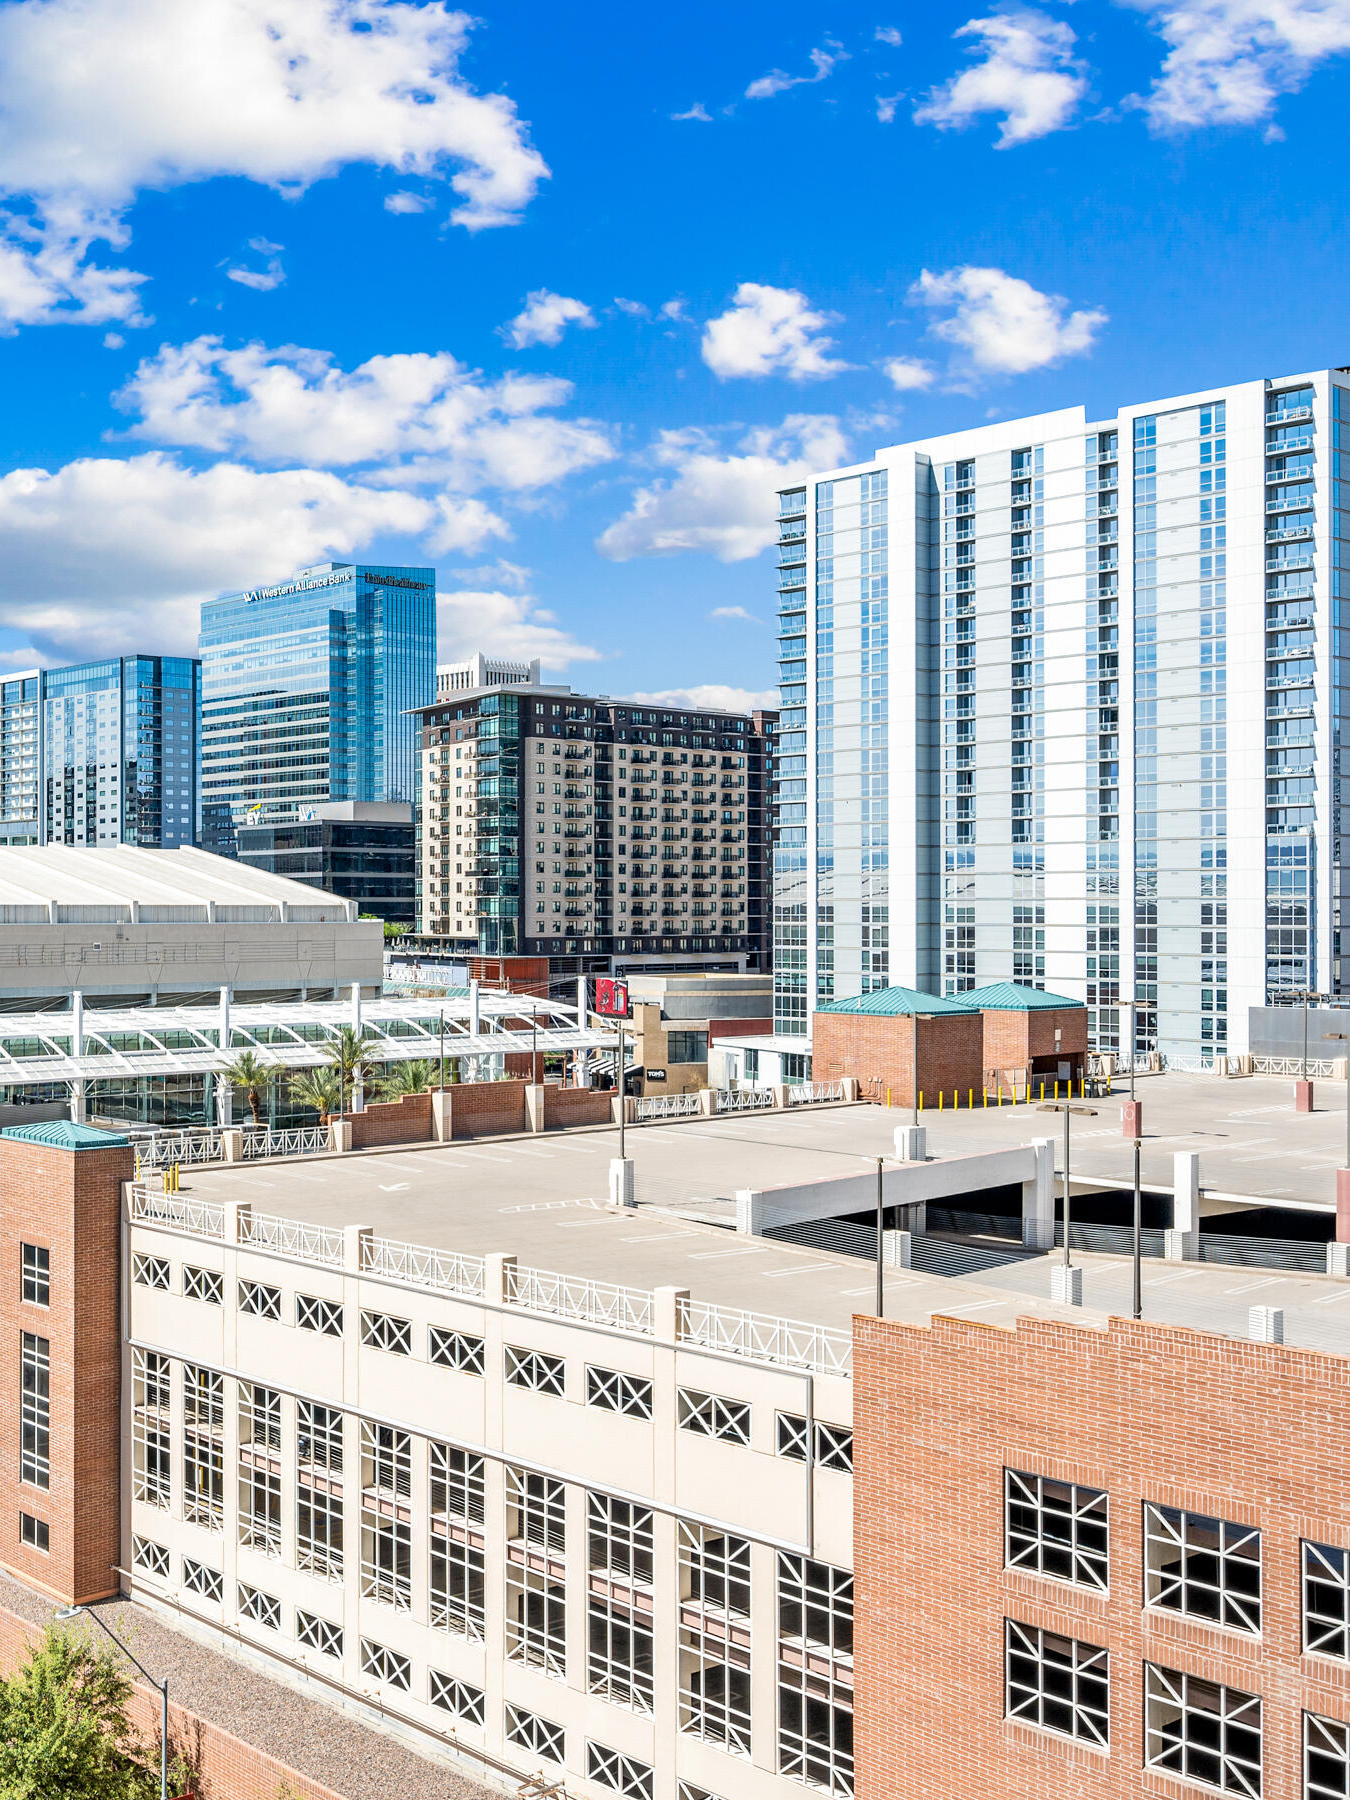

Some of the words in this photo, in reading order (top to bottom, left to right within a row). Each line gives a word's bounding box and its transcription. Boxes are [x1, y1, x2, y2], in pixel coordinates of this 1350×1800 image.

[261, 584, 295, 600] Western
[295, 577, 328, 592] Alliance
[329, 571, 352, 585] Bank
[246, 812, 261, 826] EY
